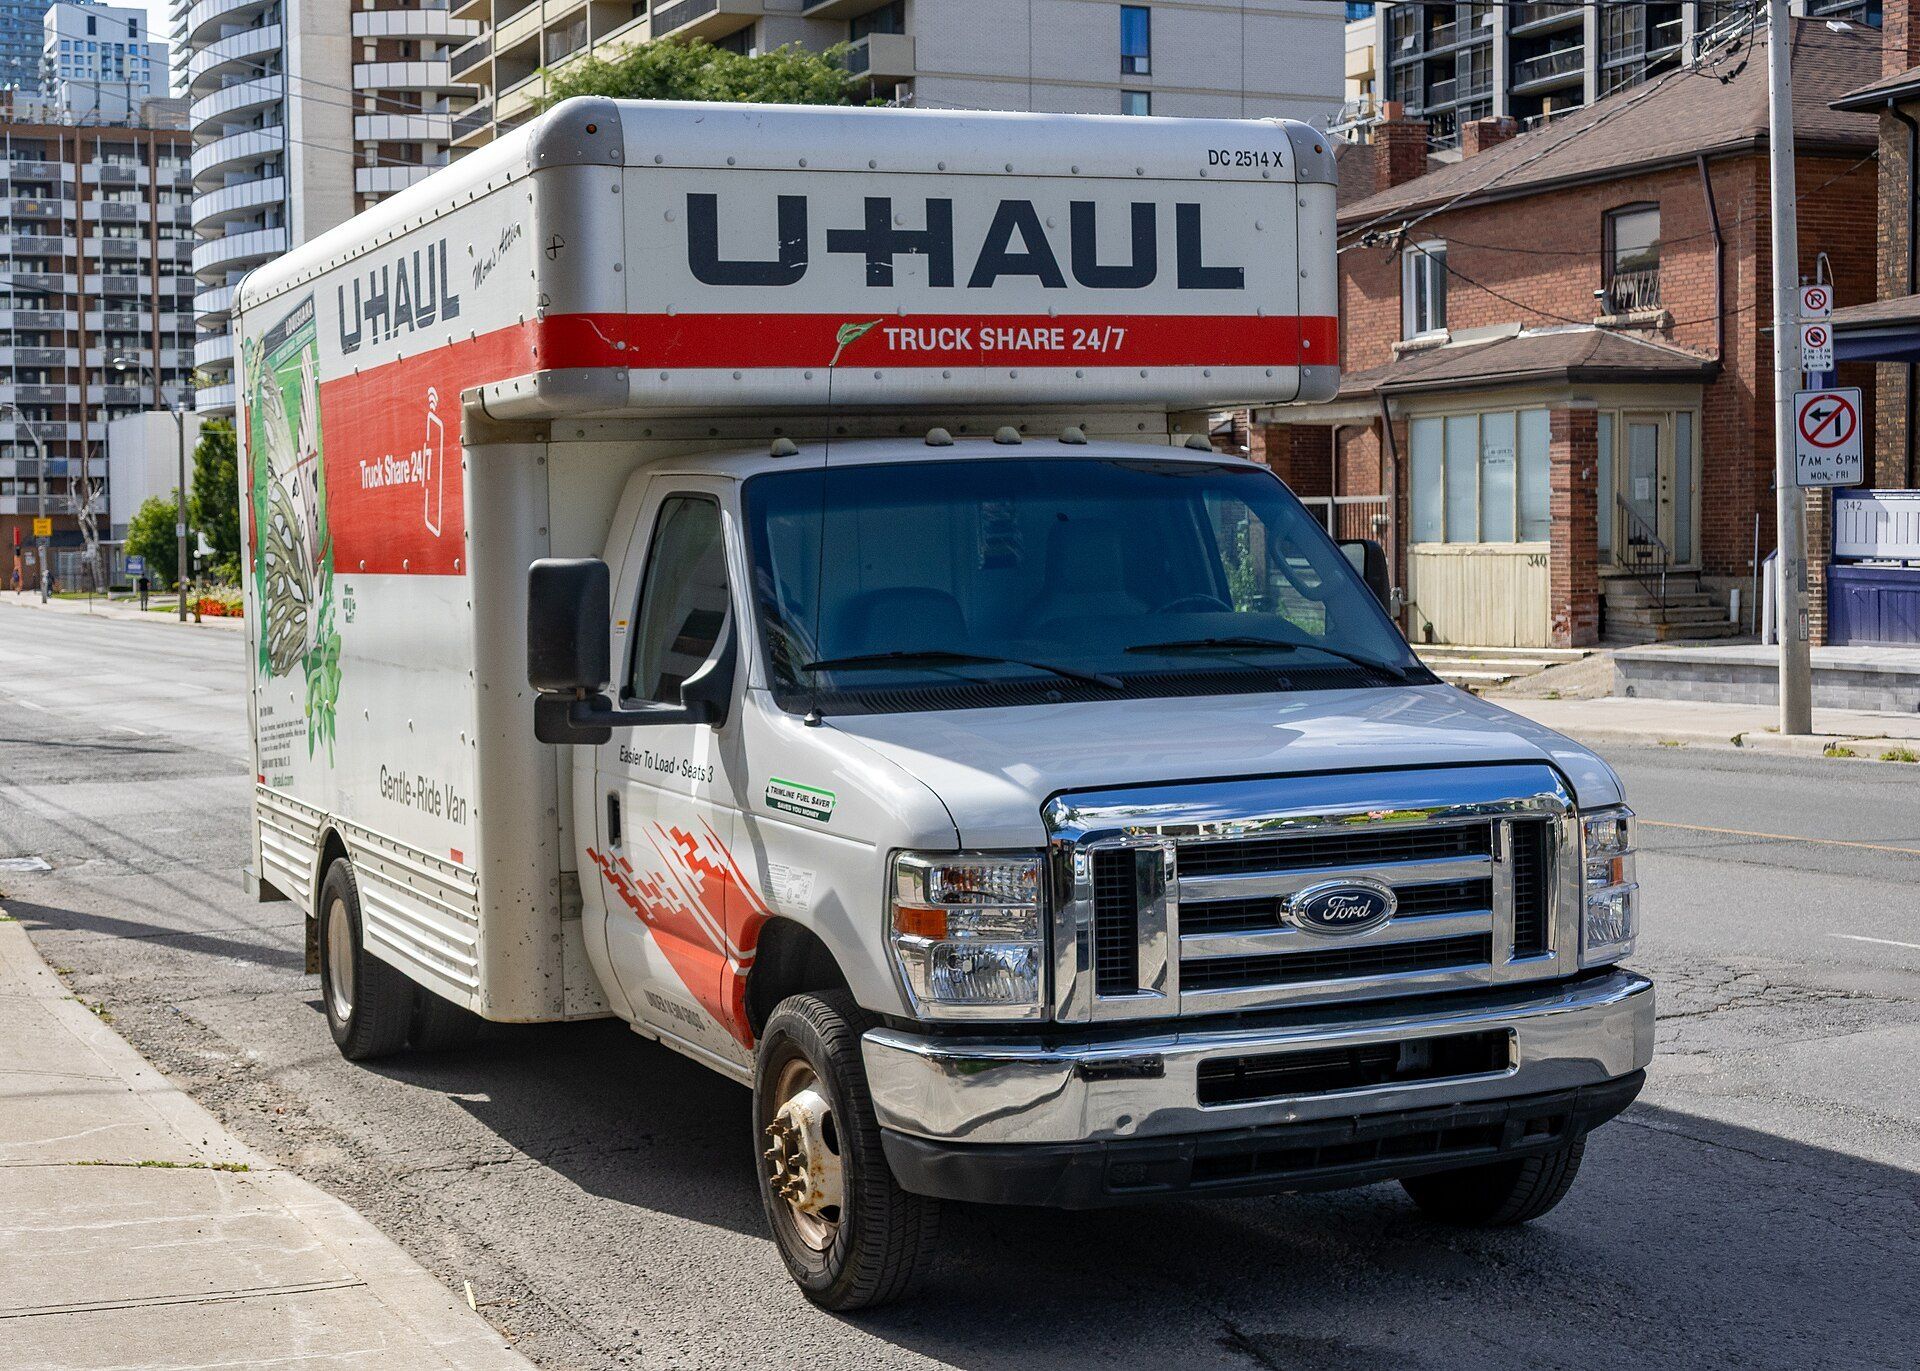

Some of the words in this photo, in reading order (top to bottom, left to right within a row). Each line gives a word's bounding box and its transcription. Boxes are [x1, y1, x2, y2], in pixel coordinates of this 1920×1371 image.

[1208, 149, 1231, 166] DC
[1235, 150, 1270, 168] 2514
[1272, 151, 1284, 168] X
[686, 192, 1245, 289] U-HAUL
[338, 237, 460, 356] U-HAUL
[883, 327, 973, 350] TRUCK
[979, 327, 1065, 350] SHARE
[1072, 326, 1126, 353] 24/7
[360, 457, 384, 489] Truck
[384, 454, 410, 486] Share
[410, 442, 432, 488] 24/7
[1843, 500, 1862, 511] 342
[1527, 553, 1548, 568] 340
[619, 744, 642, 766] Easier
[644, 750, 653, 769] To
[655, 752, 676, 774] Load
[681, 758, 706, 782] Seats
[707, 765, 714, 783] 3
[380, 763, 442, 818] Gentle-Ride
[445, 783, 466, 826] Van
[796, 792, 810, 804] FUEL
[1322, 895, 1372, 921] Ford
